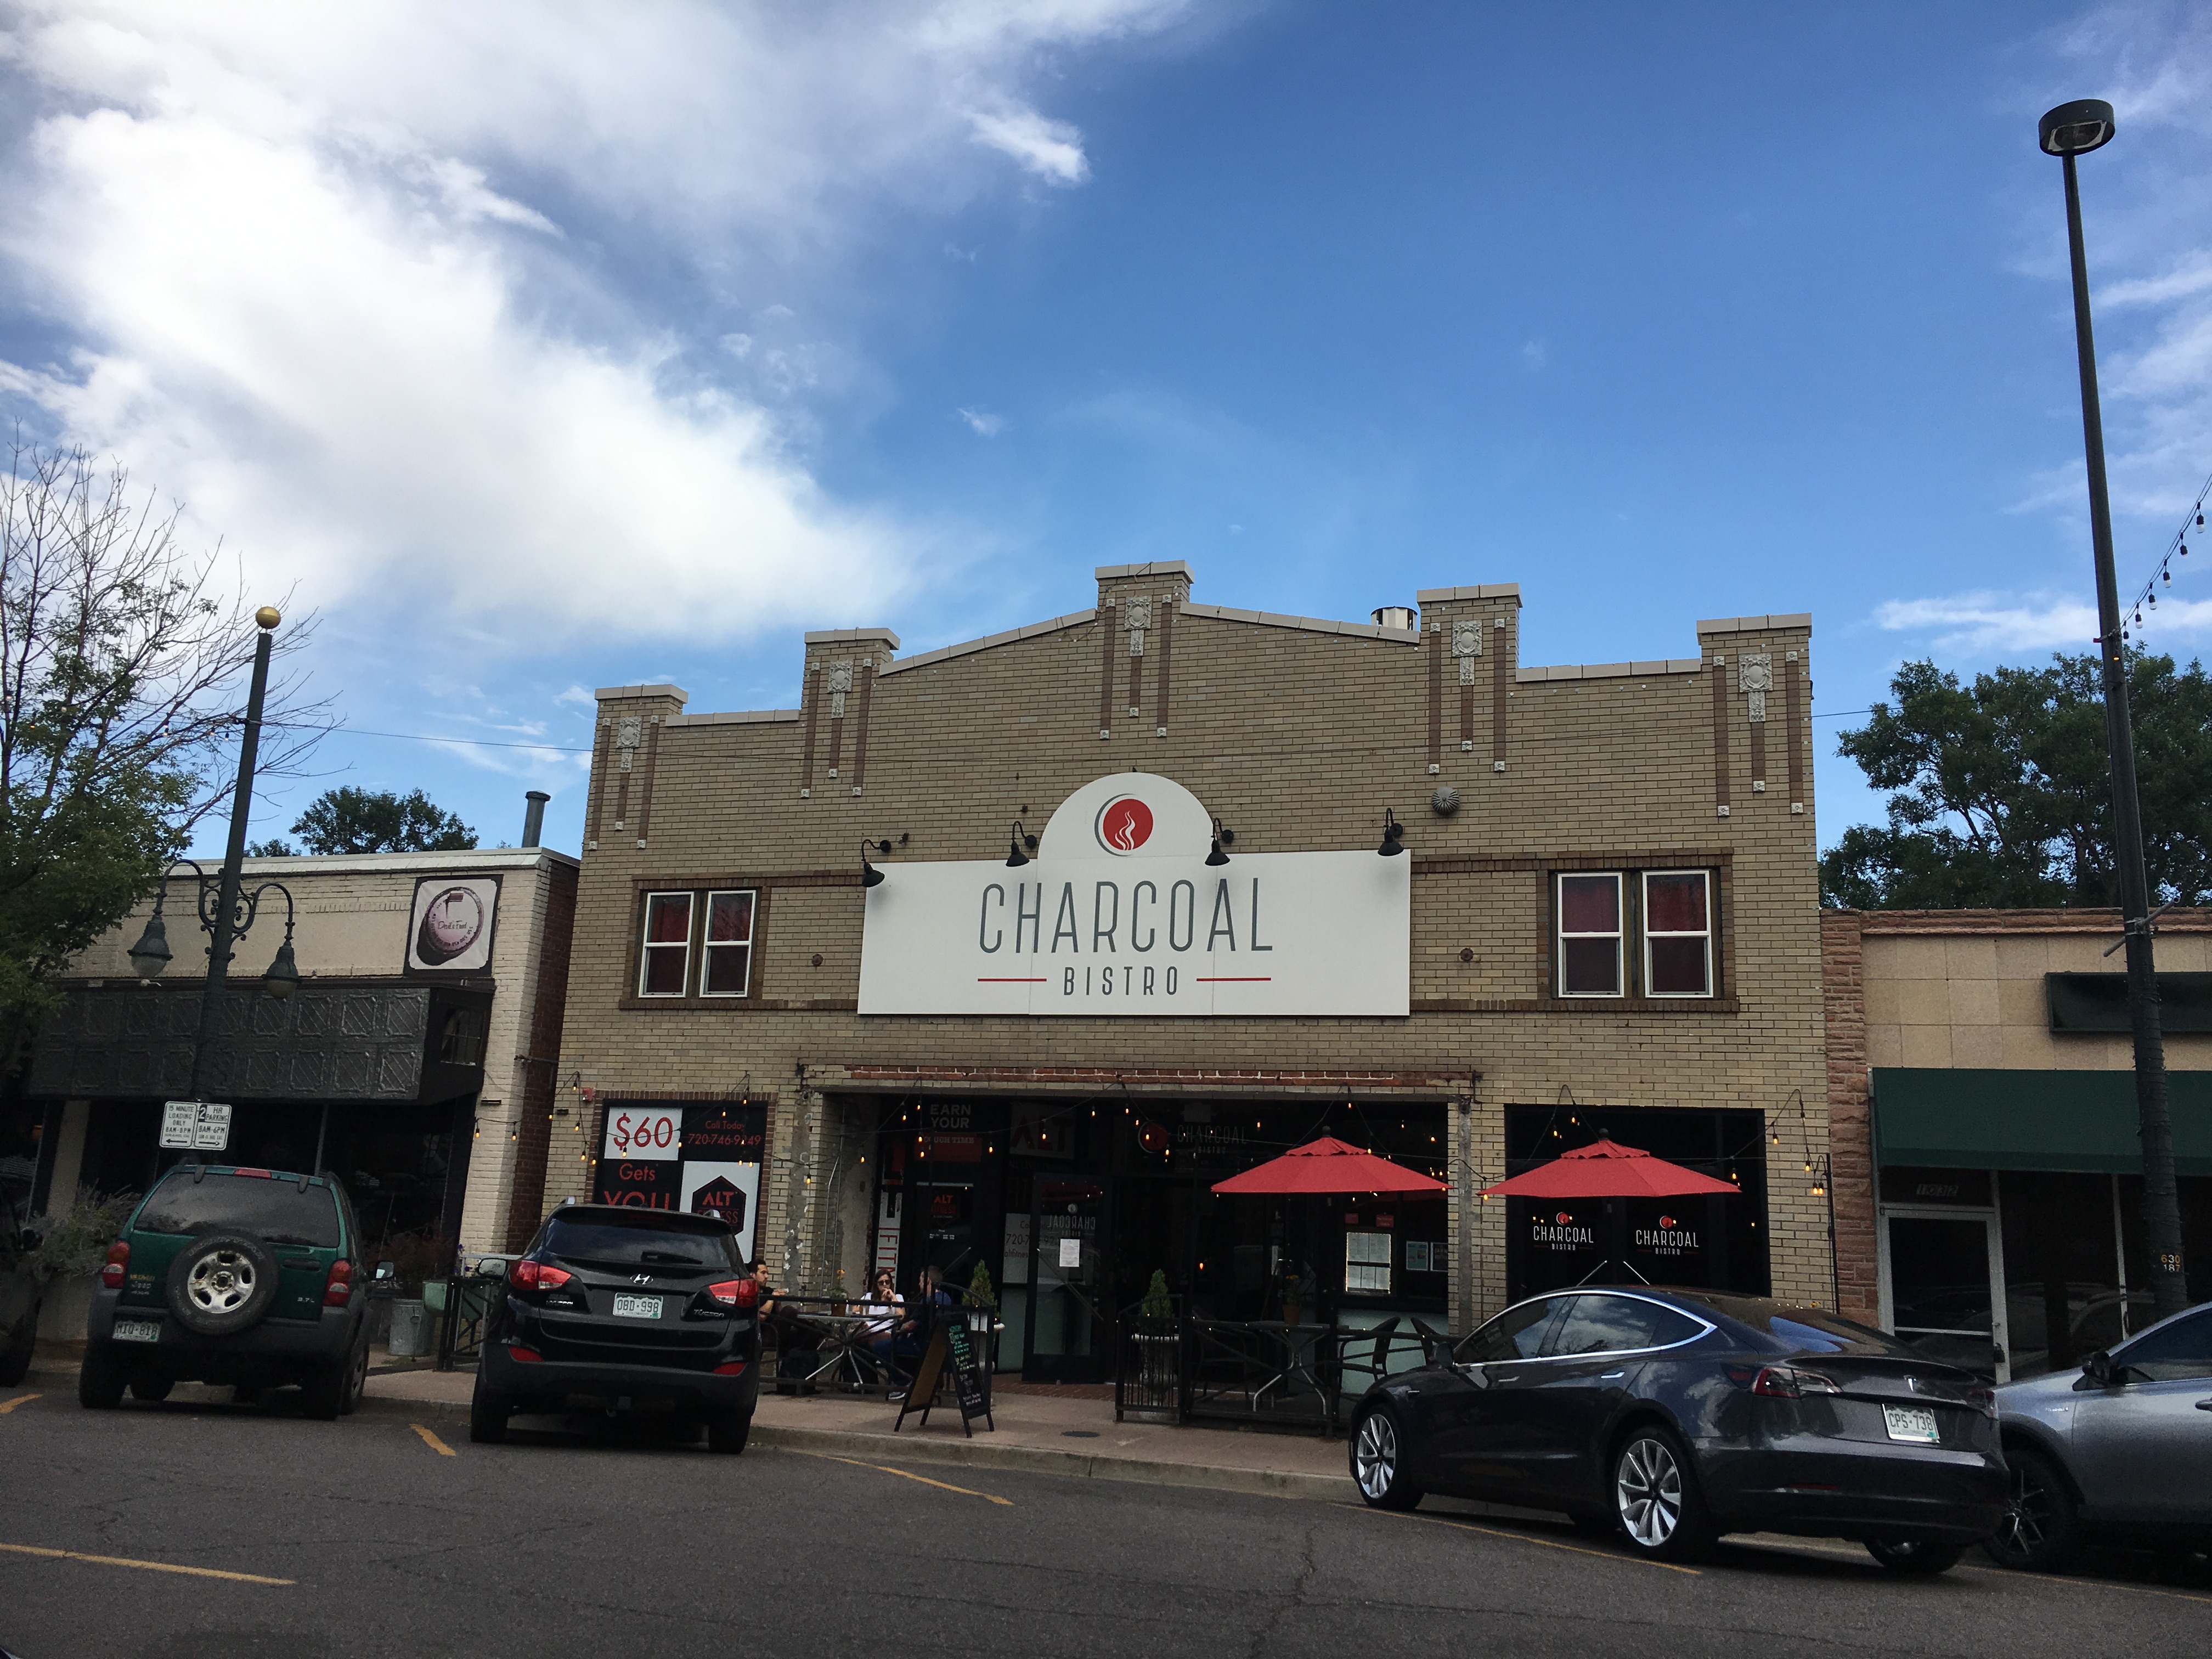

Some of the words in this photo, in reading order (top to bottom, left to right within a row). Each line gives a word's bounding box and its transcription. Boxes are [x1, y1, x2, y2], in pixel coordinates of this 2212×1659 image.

[979, 878, 1273, 953] CHARCOAL
[1064, 966, 1178, 996] BISTRO
[199, 1107, 206, 1119] 2
[930, 1104, 972, 1115] EARN
[705, 1121, 720, 1130] Call
[723, 1121, 745, 1131] Today
[931, 1117, 969, 1128] YOUR
[199, 1125, 225, 1134] 8AM-6PM
[613, 1113, 673, 1150] $60
[1177, 1125, 1248, 1144] CHARCOAL
[619, 1163, 656, 1182] Gets
[1920, 1184, 1956, 1195] 1032
[702, 1191, 735, 1206] ALT
[934, 1194, 954, 1204] ALT
[1533, 1226, 1594, 1243] CHARCOAL
[1636, 1229, 1699, 1248] CHARCOAL
[2161, 1254, 2180, 1264] 630
[2163, 1263, 2181, 1272] 187
